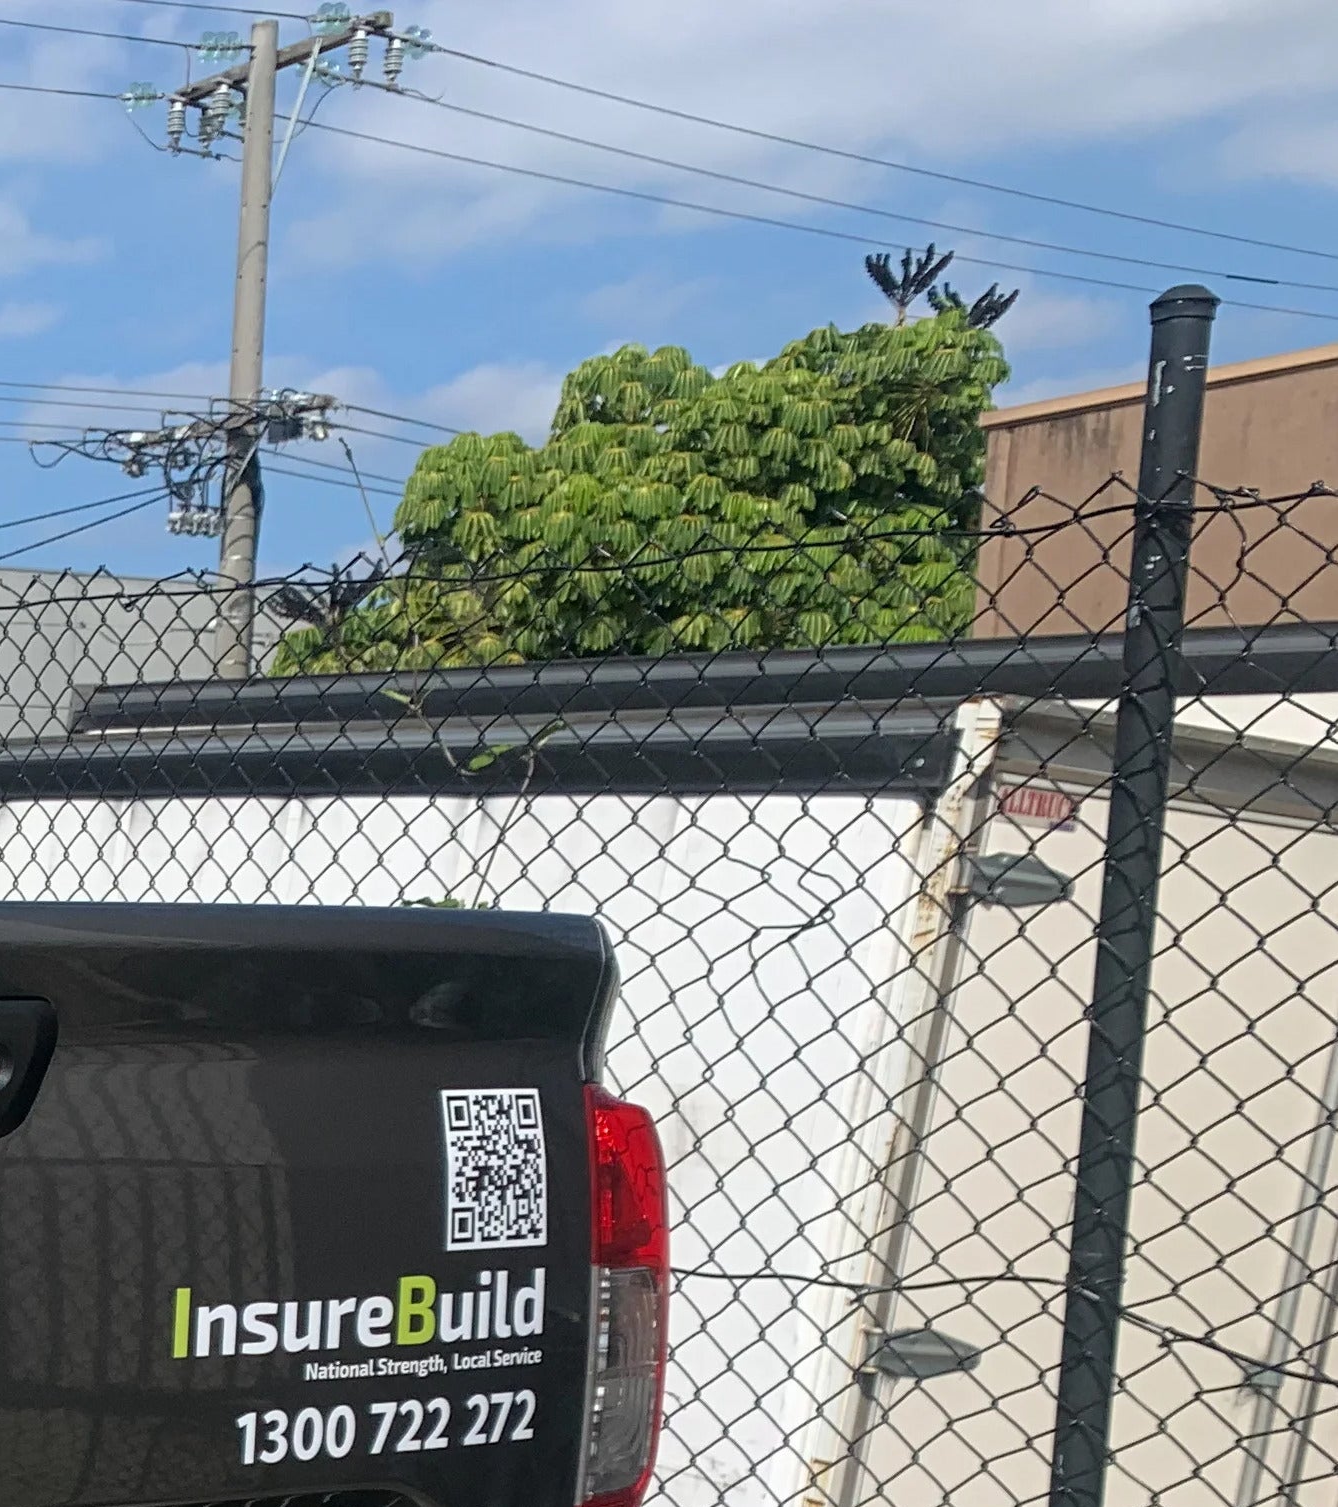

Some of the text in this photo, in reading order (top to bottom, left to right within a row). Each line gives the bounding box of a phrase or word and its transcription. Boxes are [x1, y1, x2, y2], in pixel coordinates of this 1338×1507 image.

[172, 1267, 546, 1359] InsureBuild
[304, 1347, 543, 1382] National Strength, Local Service
[236, 1389, 537, 1465] 1300 722 272
